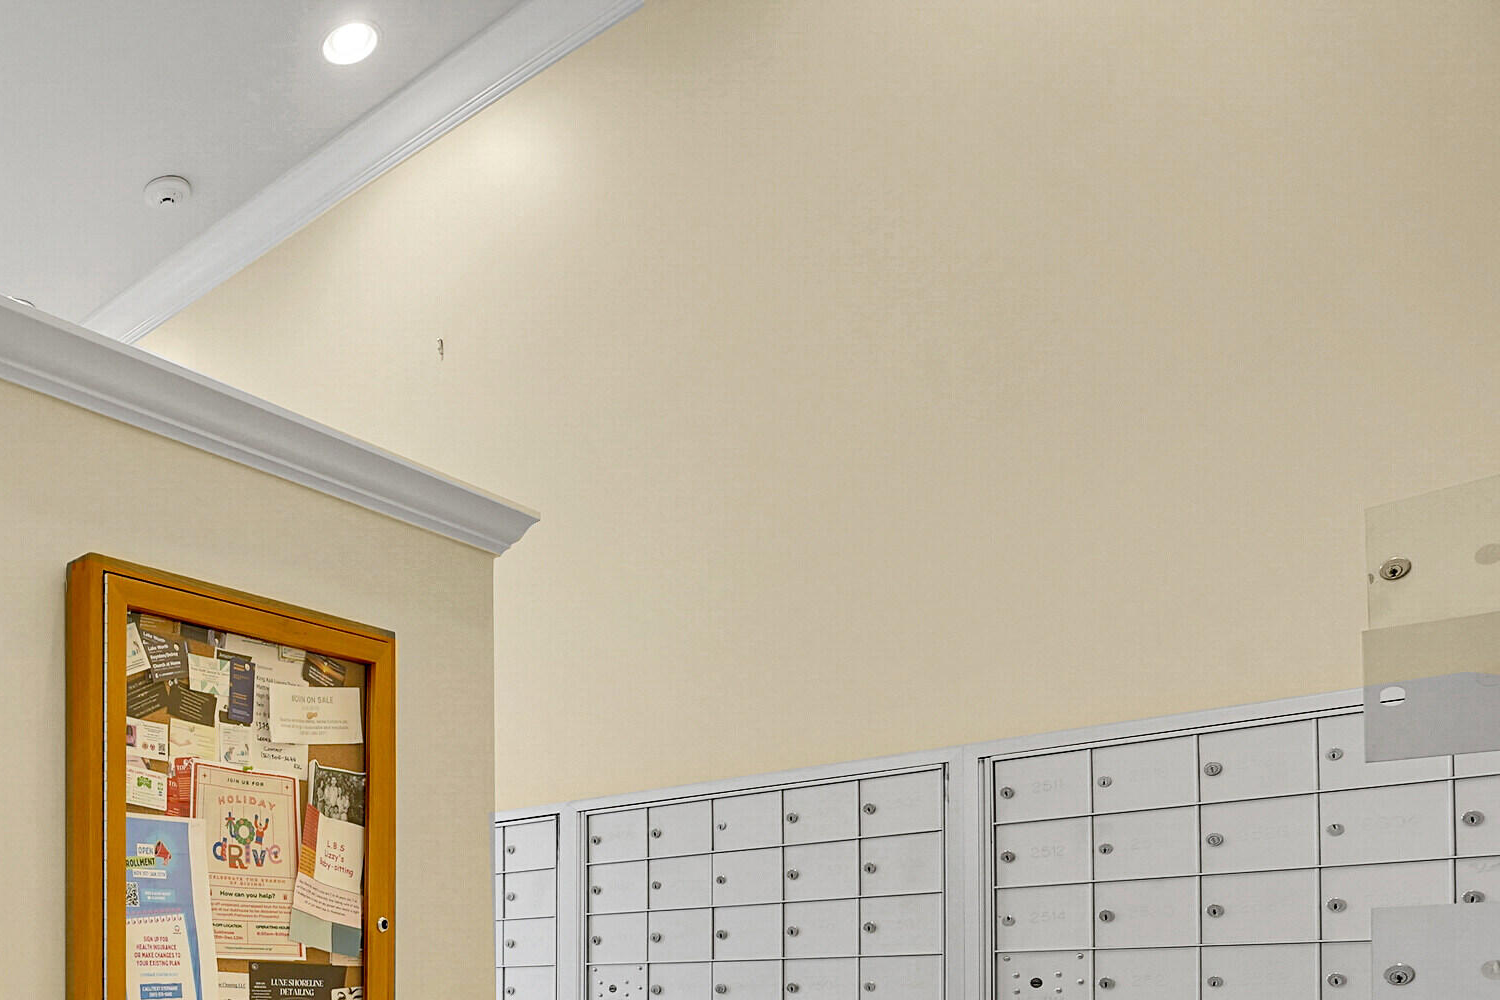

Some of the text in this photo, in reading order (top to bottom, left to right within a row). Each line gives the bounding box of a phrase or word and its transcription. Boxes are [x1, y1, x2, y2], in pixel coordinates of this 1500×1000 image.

[218, 795, 276, 811] HOLIDAY
[258, 892, 276, 900] help?
[270, 978, 324, 988] LUXE SHORELINE
[279, 988, 315, 997] DETAILING
